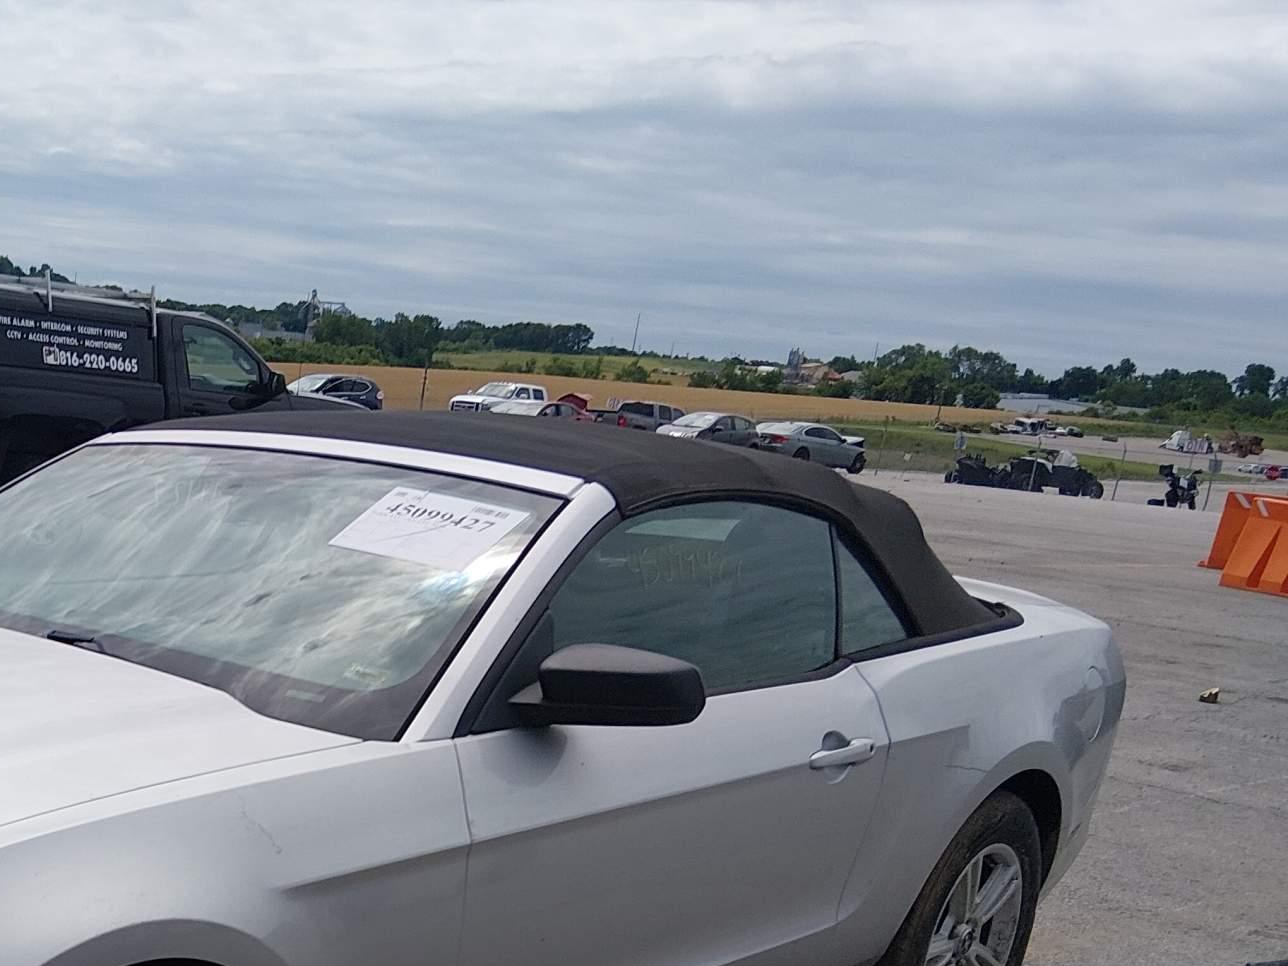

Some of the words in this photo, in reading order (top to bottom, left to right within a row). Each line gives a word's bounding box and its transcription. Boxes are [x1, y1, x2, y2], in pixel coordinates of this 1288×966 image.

[12, 317, 34, 328] ALARM
[41, 321, 71, 333] INTERCOM
[77, 325, 103, 337] SECURITY
[104, 328, 128, 339] SYSTEMS
[6, 330, 21, 339] CCTV
[28, 332, 49, 343] ACCESS
[50, 335, 79, 346] CONTROL
[84, 339, 123, 351] MONITORING
[59, 350, 138, 373] 816-220-0665
[386, 503, 496, 533] 45099427
